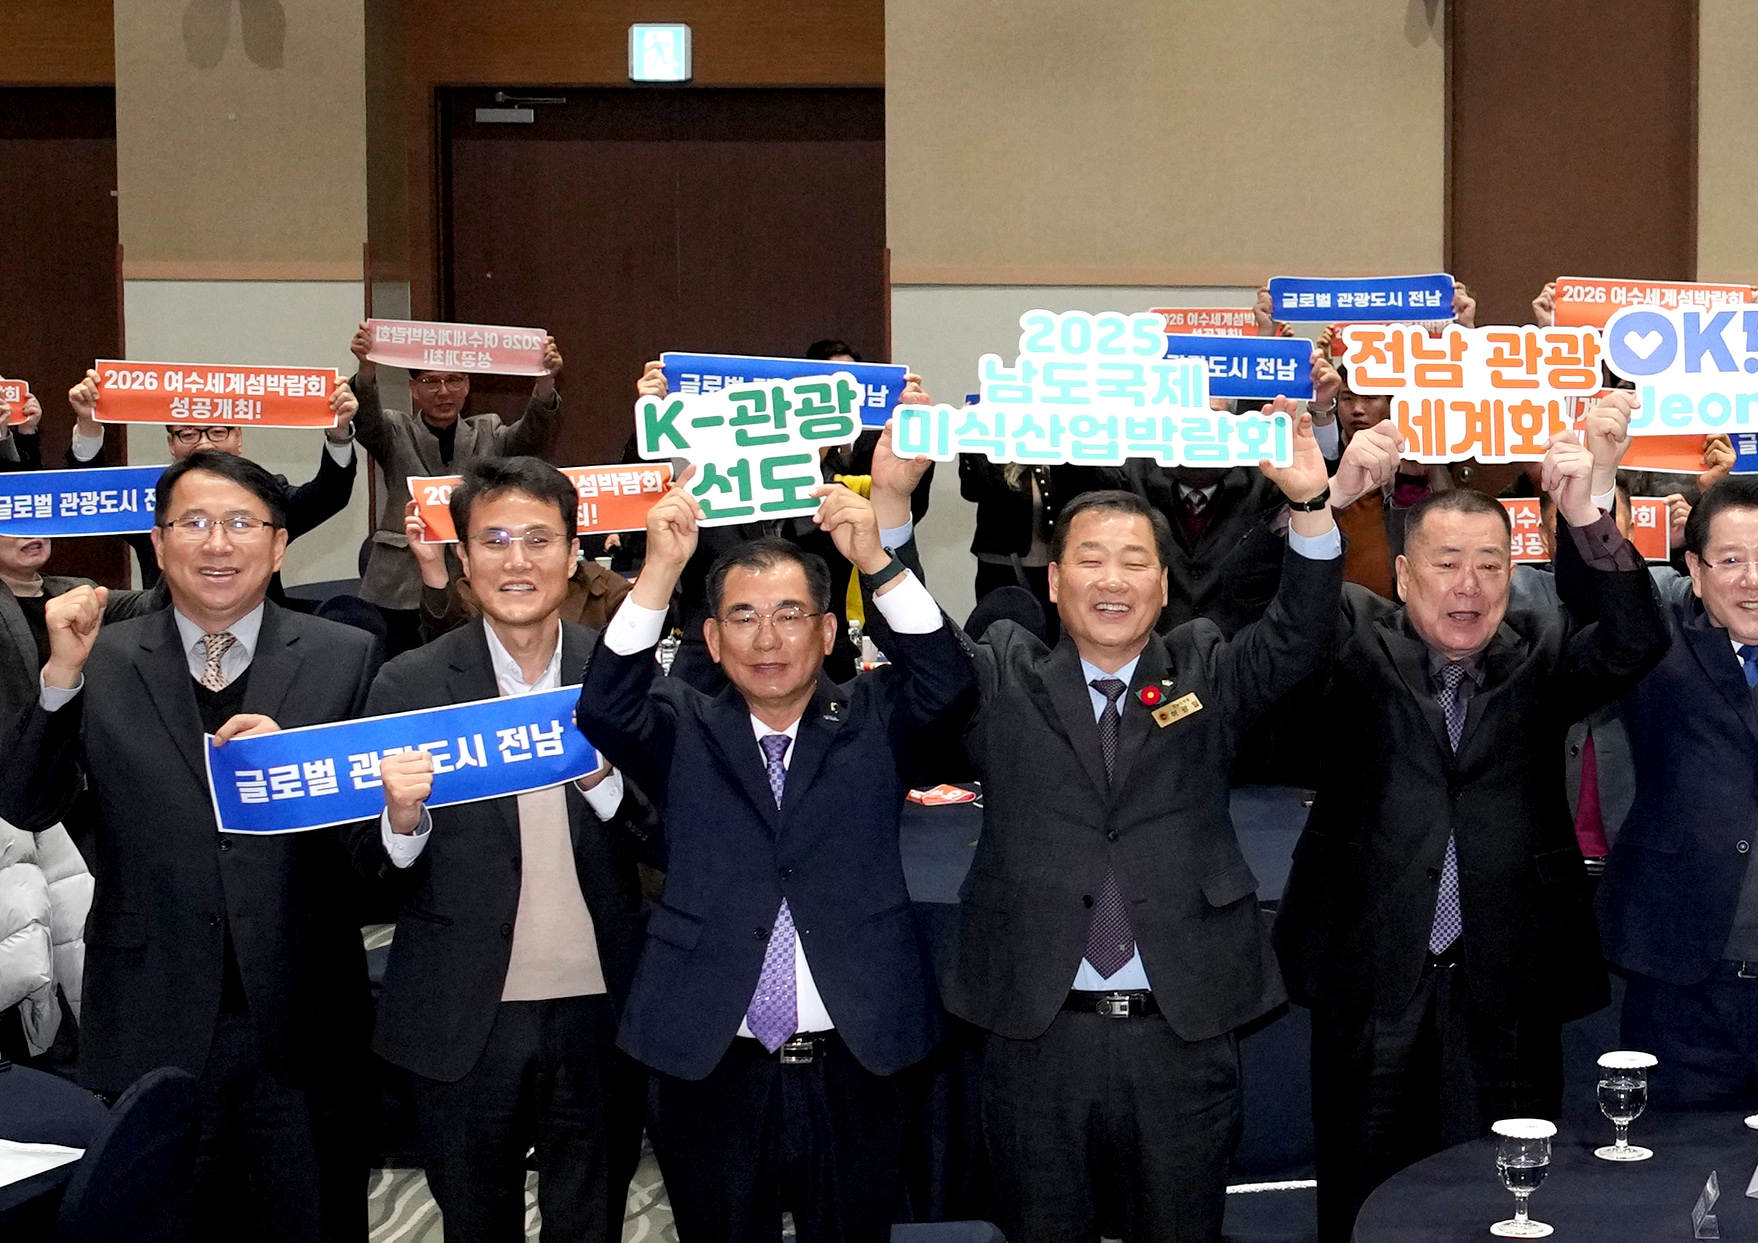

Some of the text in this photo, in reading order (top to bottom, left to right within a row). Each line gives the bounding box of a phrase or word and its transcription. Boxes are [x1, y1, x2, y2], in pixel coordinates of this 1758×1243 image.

[1282, 290, 1442, 309] 글로벌 관광도시 전남
[1562, 286, 1606, 303] 2026
[1025, 315, 1162, 356] 2025
[1255, 357, 1298, 381] 전남
[1350, 329, 1600, 389] 전남 관광
[104, 370, 326, 397] 2026 여수세계섬박람회
[984, 359, 1203, 408] 남도국제
[169, 397, 262, 420] 성공개최!
[644, 379, 857, 452] K-관광
[1398, 399, 1567, 456] 세계화
[899, 409, 1288, 462] 미식산업박람회
[59, 489, 137, 517] 관광도시
[692, 454, 822, 519] 선도
[235, 720, 565, 804] 글로벌 관도시 전남
